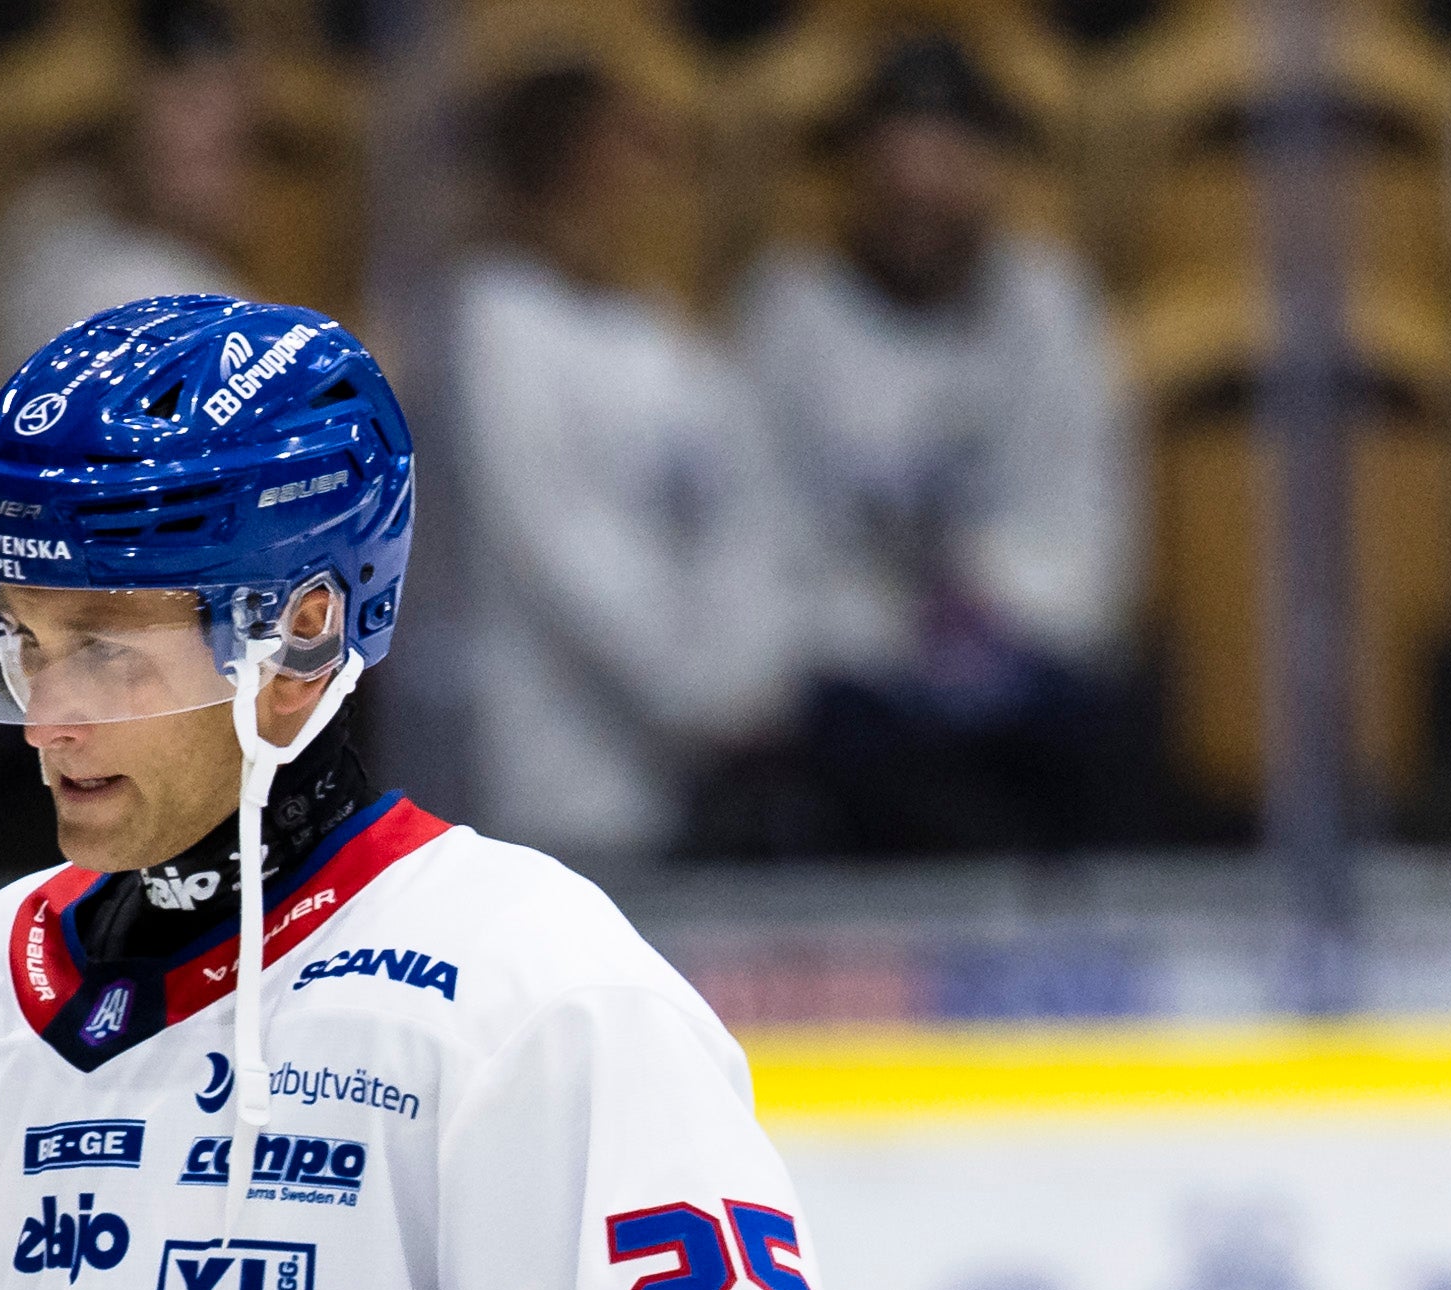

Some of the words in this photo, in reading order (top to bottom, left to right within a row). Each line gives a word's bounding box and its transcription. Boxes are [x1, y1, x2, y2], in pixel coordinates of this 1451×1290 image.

[202, 388, 243, 426] EB
[228, 324, 317, 399] Gruppen
[257, 469, 349, 508] BAUER
[292, 948, 459, 1002] SCANIA
